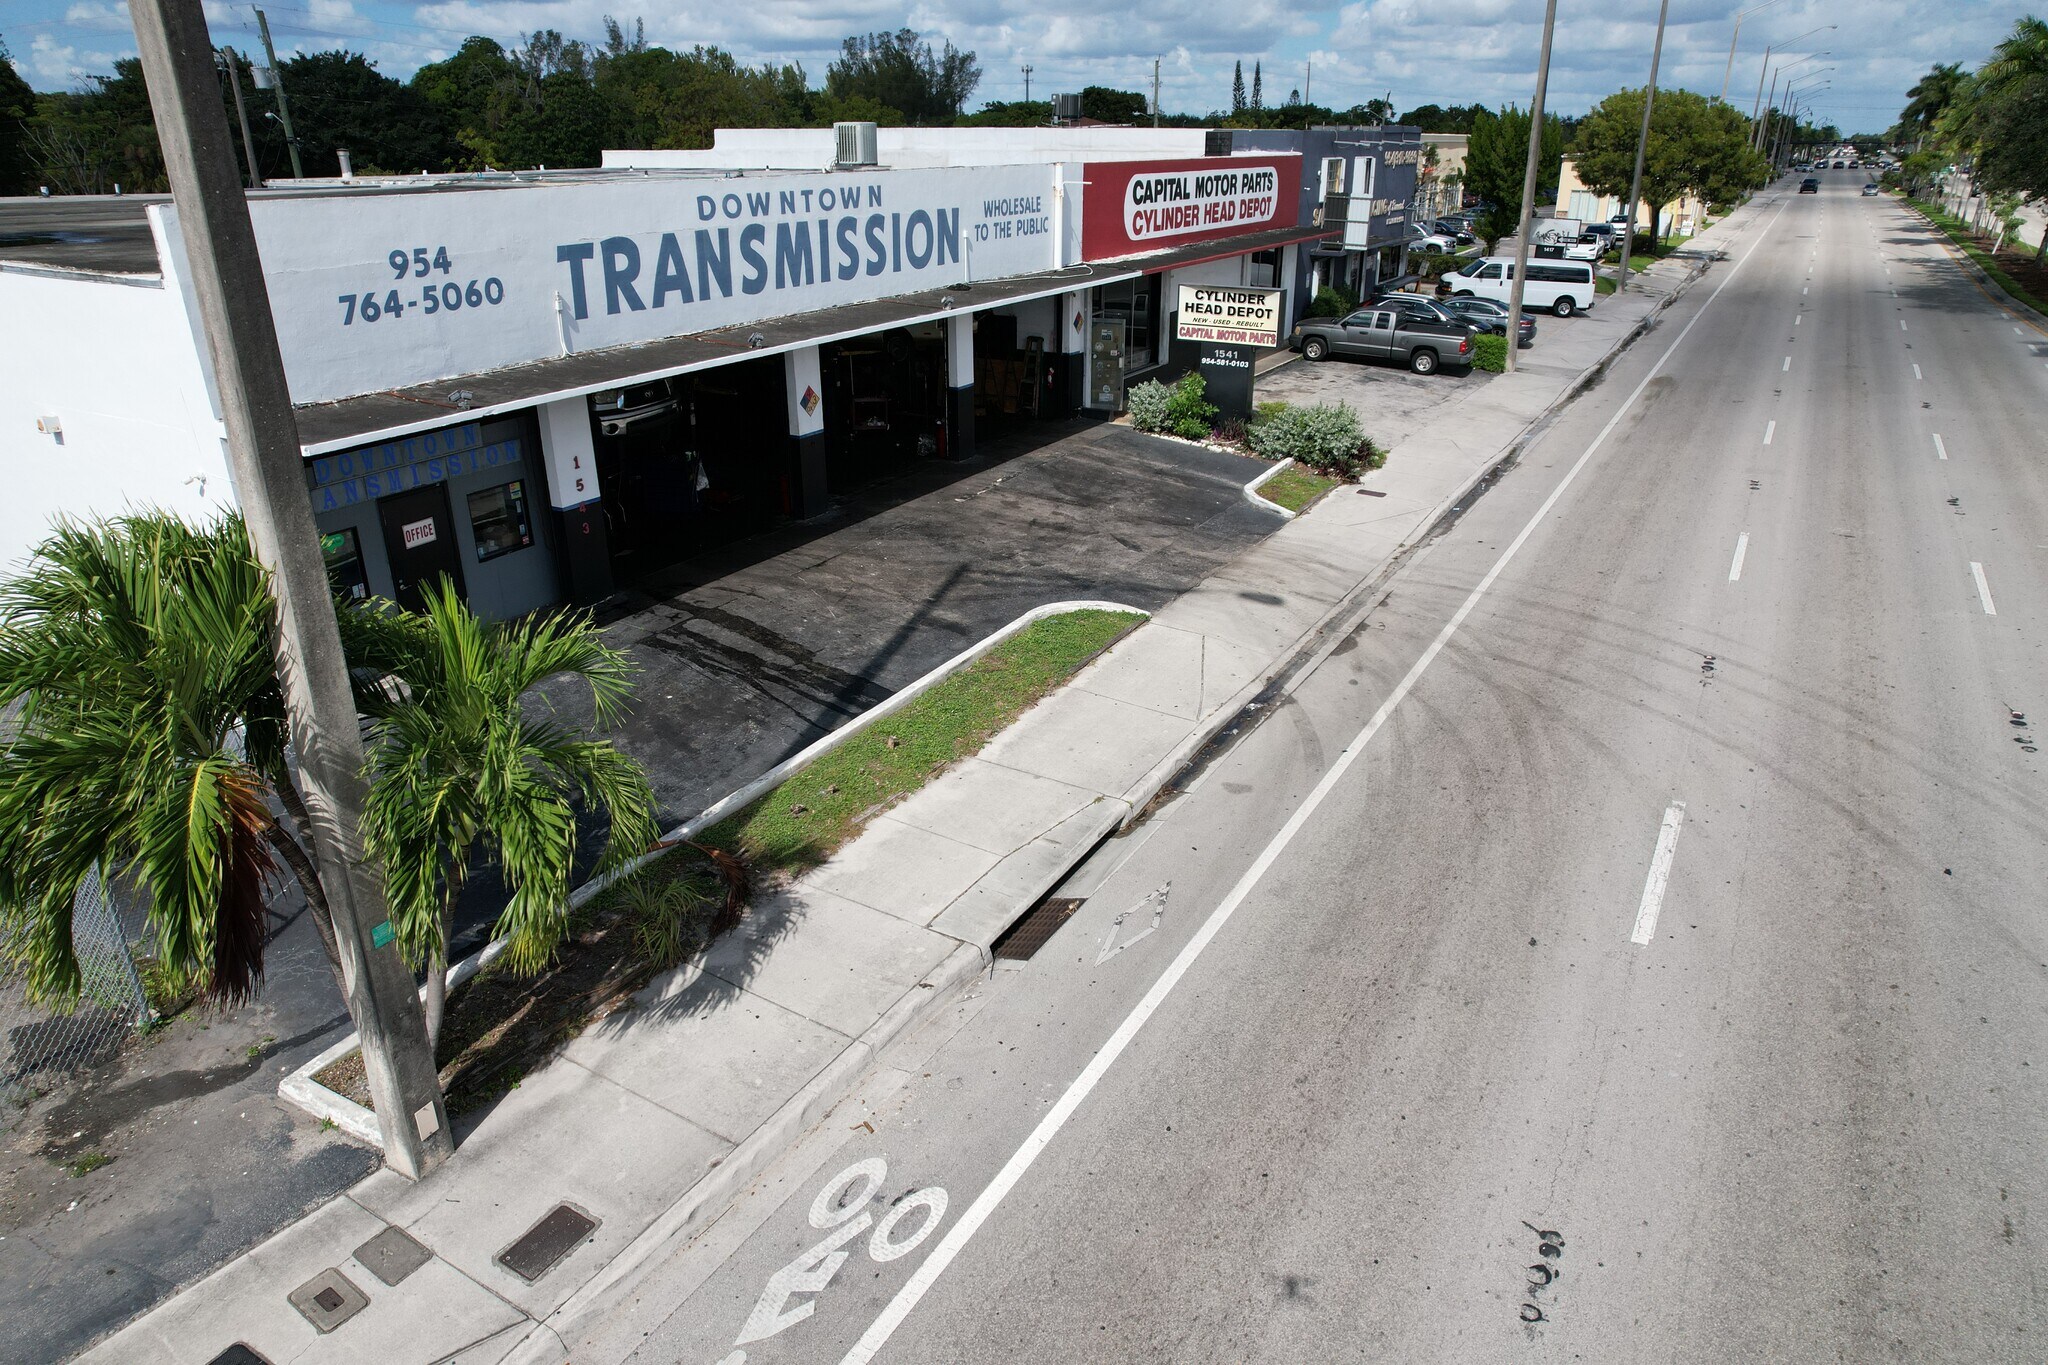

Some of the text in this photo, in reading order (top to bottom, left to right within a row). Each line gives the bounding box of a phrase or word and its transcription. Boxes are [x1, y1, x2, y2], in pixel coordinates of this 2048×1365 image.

[697, 185, 882, 221] DOWNTOWN
[1132, 171, 1274, 205] CAPITAL MOTOR PARTS
[983, 196, 1041, 218] WHOLESALE
[1132, 196, 1272, 236] CYLINDER HEAD DEPOT
[974, 216, 1049, 242] TO THE PUBLIC
[388, 245, 452, 280] 954
[556, 206, 960, 321] TRANSMISSION
[338, 277, 504, 326] 764-5060
[1185, 302, 1272, 319] HEAD DEPOT
[1195, 290, 1265, 305] CYLINDER
[1179, 326, 1276, 344] CAPITAL MOTOR PARTS
[1201, 357, 1249, 368] 954-581-0103
[1214, 349, 1238, 359] 1541
[316, 424, 476, 484] DOWNTOWN
[323, 439, 519, 510] ANSMISSION
[405, 523, 434, 543] OFFICE
